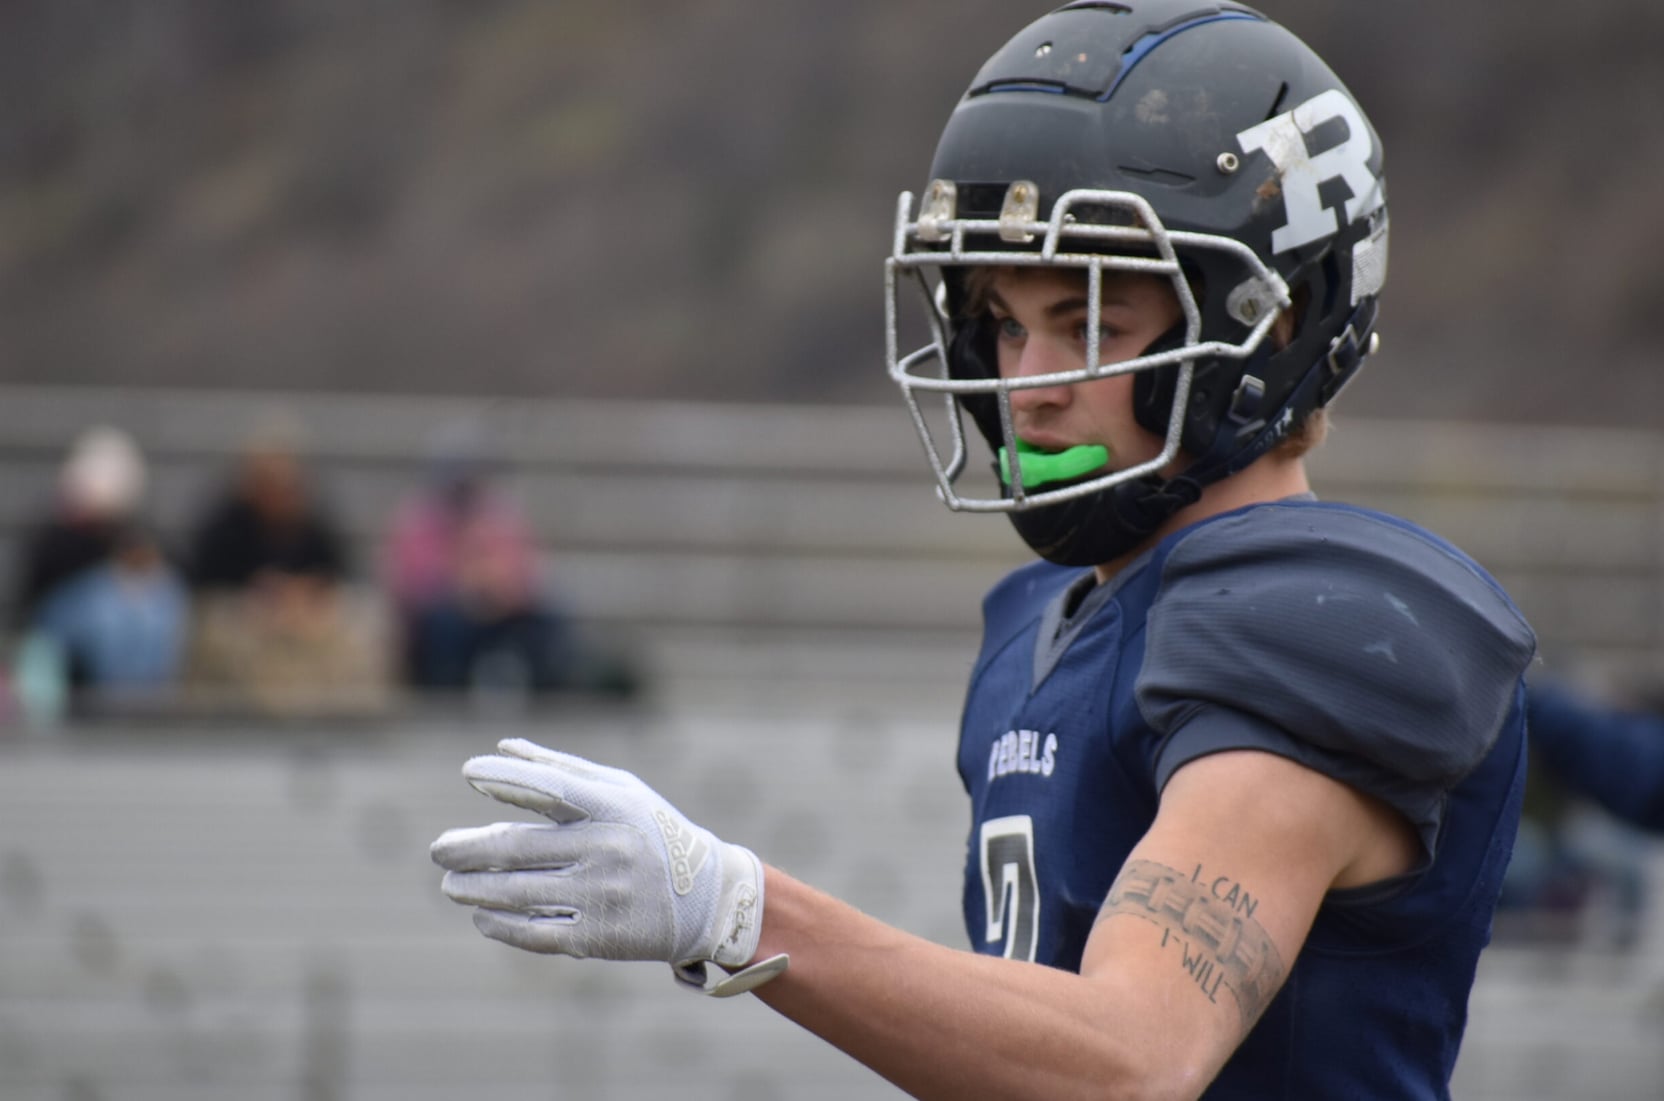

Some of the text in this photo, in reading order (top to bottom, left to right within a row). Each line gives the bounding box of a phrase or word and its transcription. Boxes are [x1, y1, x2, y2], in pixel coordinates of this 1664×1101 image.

[1236, 89, 1384, 255] R
[657, 811, 690, 890] adidas
[1212, 877, 1257, 917] CAN
[1183, 943, 1223, 1003] WILL
